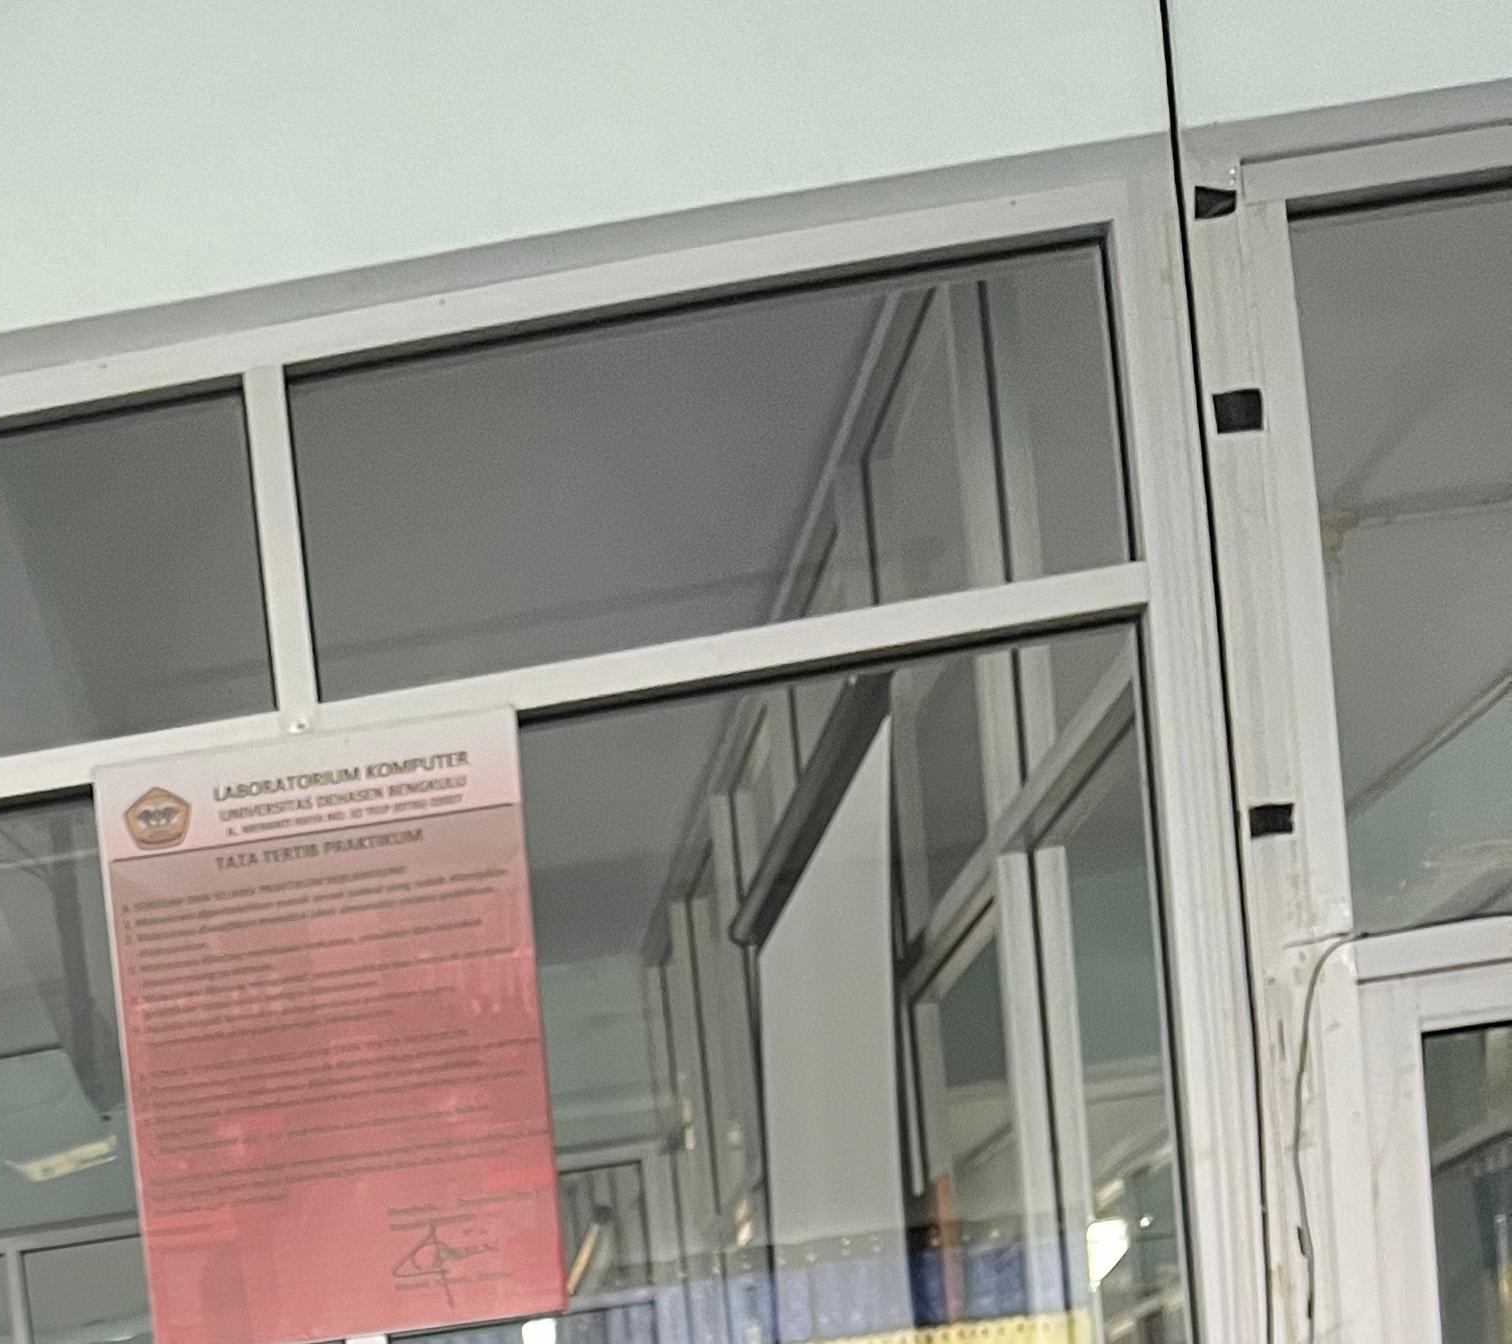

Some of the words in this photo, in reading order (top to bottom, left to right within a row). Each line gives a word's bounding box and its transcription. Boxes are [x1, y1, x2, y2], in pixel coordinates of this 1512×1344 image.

[214, 768, 360, 800] LABORATORIUM
[365, 751, 468, 778] KOMPUTER
[218, 798, 312, 821] UNIVERSITAS
[215, 852, 257, 870] TATA
[263, 844, 318, 862] TERTIB
[323, 829, 423, 854] PRAKTIKUM
